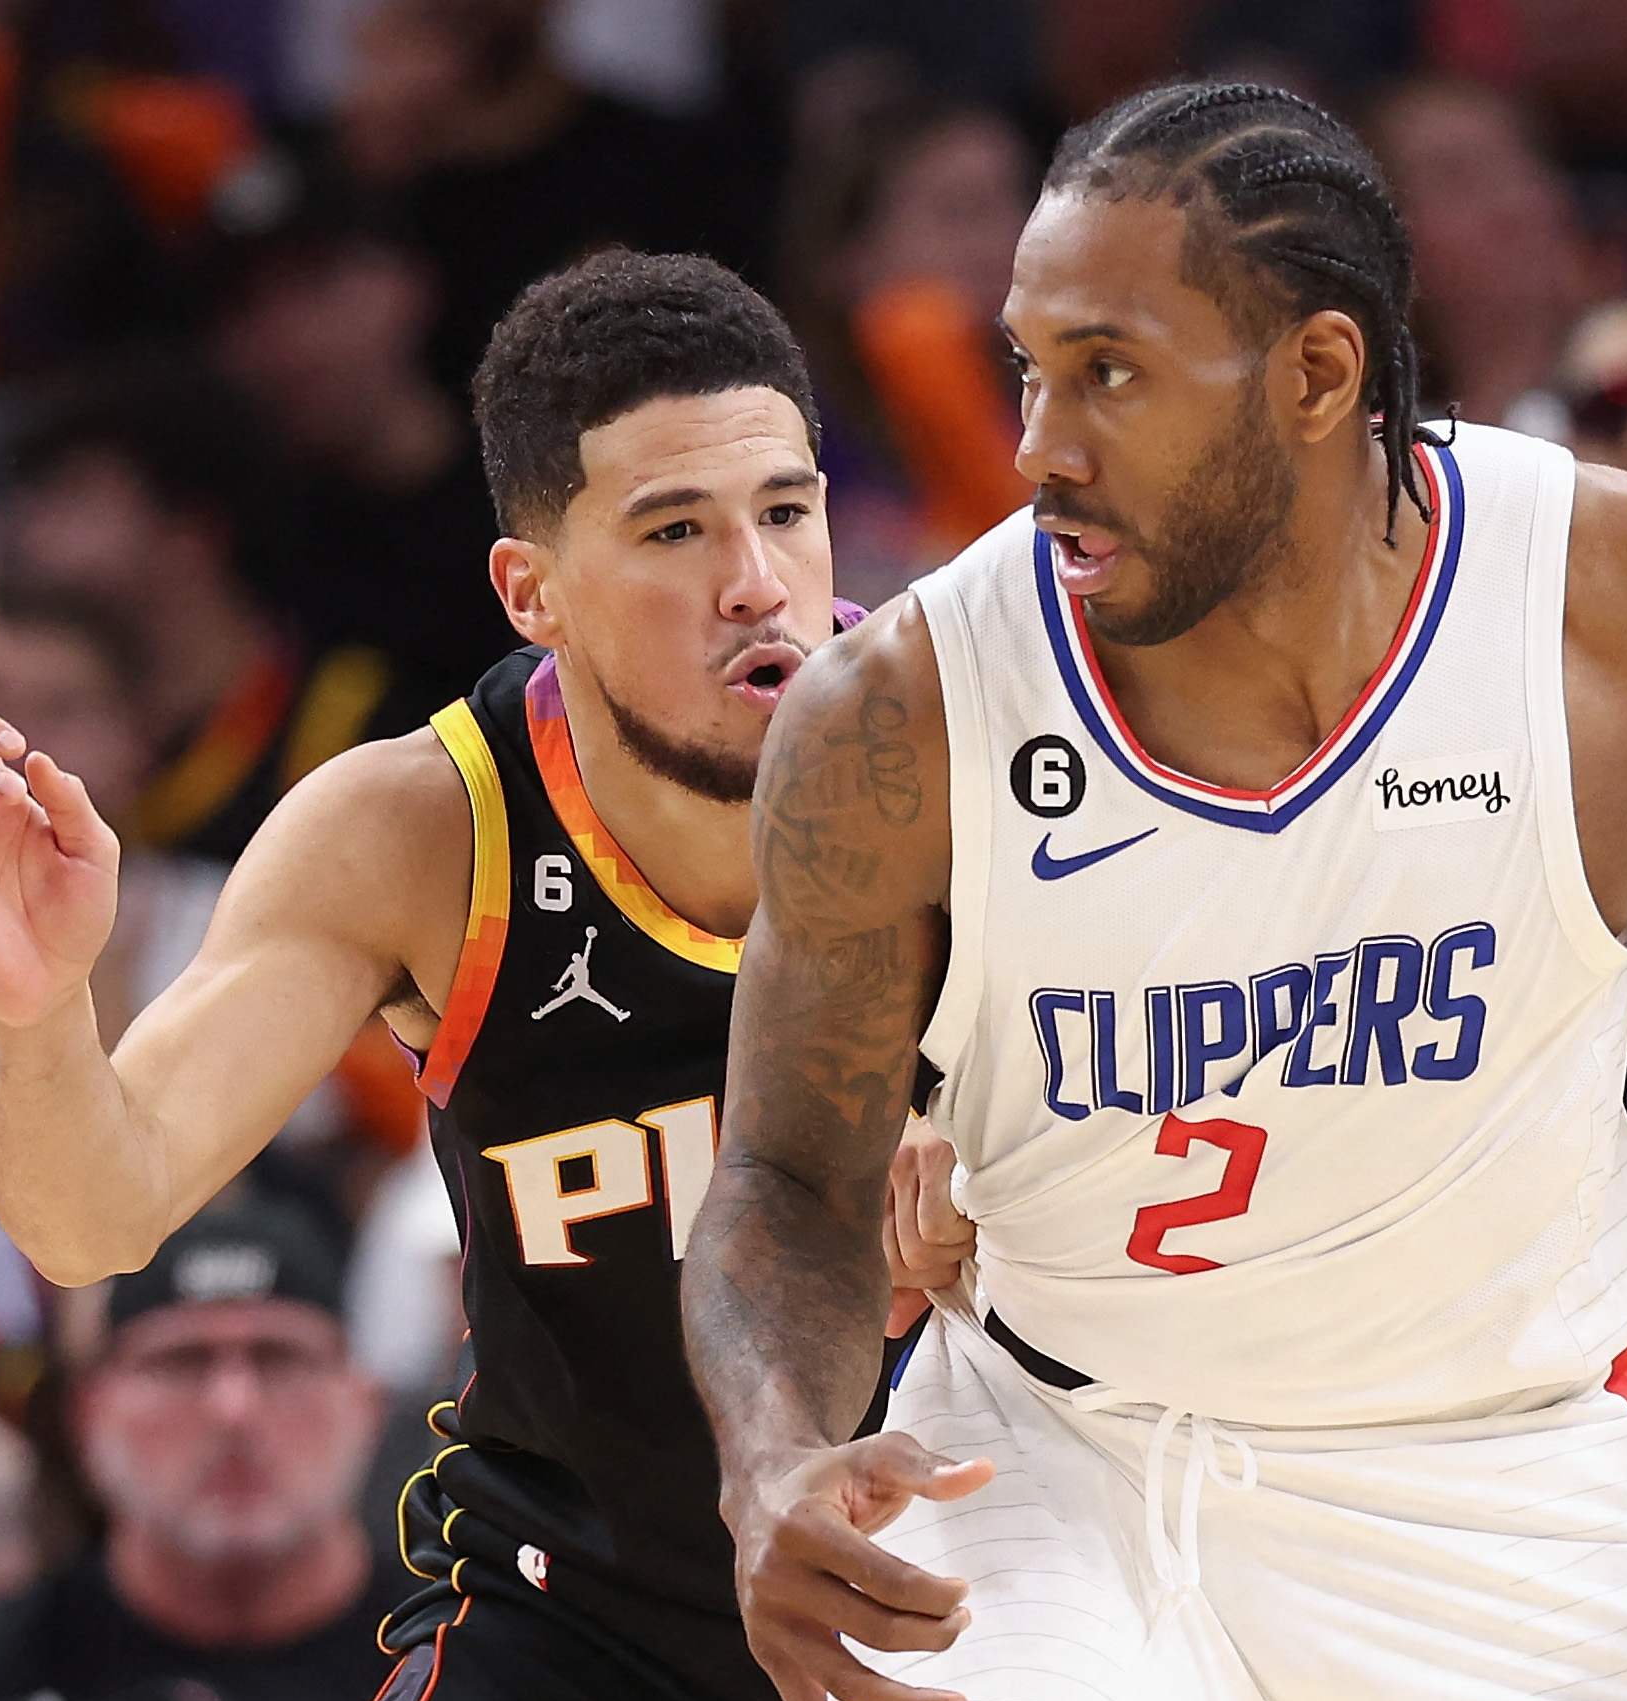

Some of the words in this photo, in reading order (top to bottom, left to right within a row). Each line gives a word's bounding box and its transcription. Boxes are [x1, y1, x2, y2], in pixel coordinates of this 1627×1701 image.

[1029, 747, 1071, 808] 6
[1374, 767, 1511, 814] honey
[533, 854, 574, 912] 6
[1028, 921, 1496, 1122] CLIPPERS
[1125, 1109, 1269, 1276] 2
